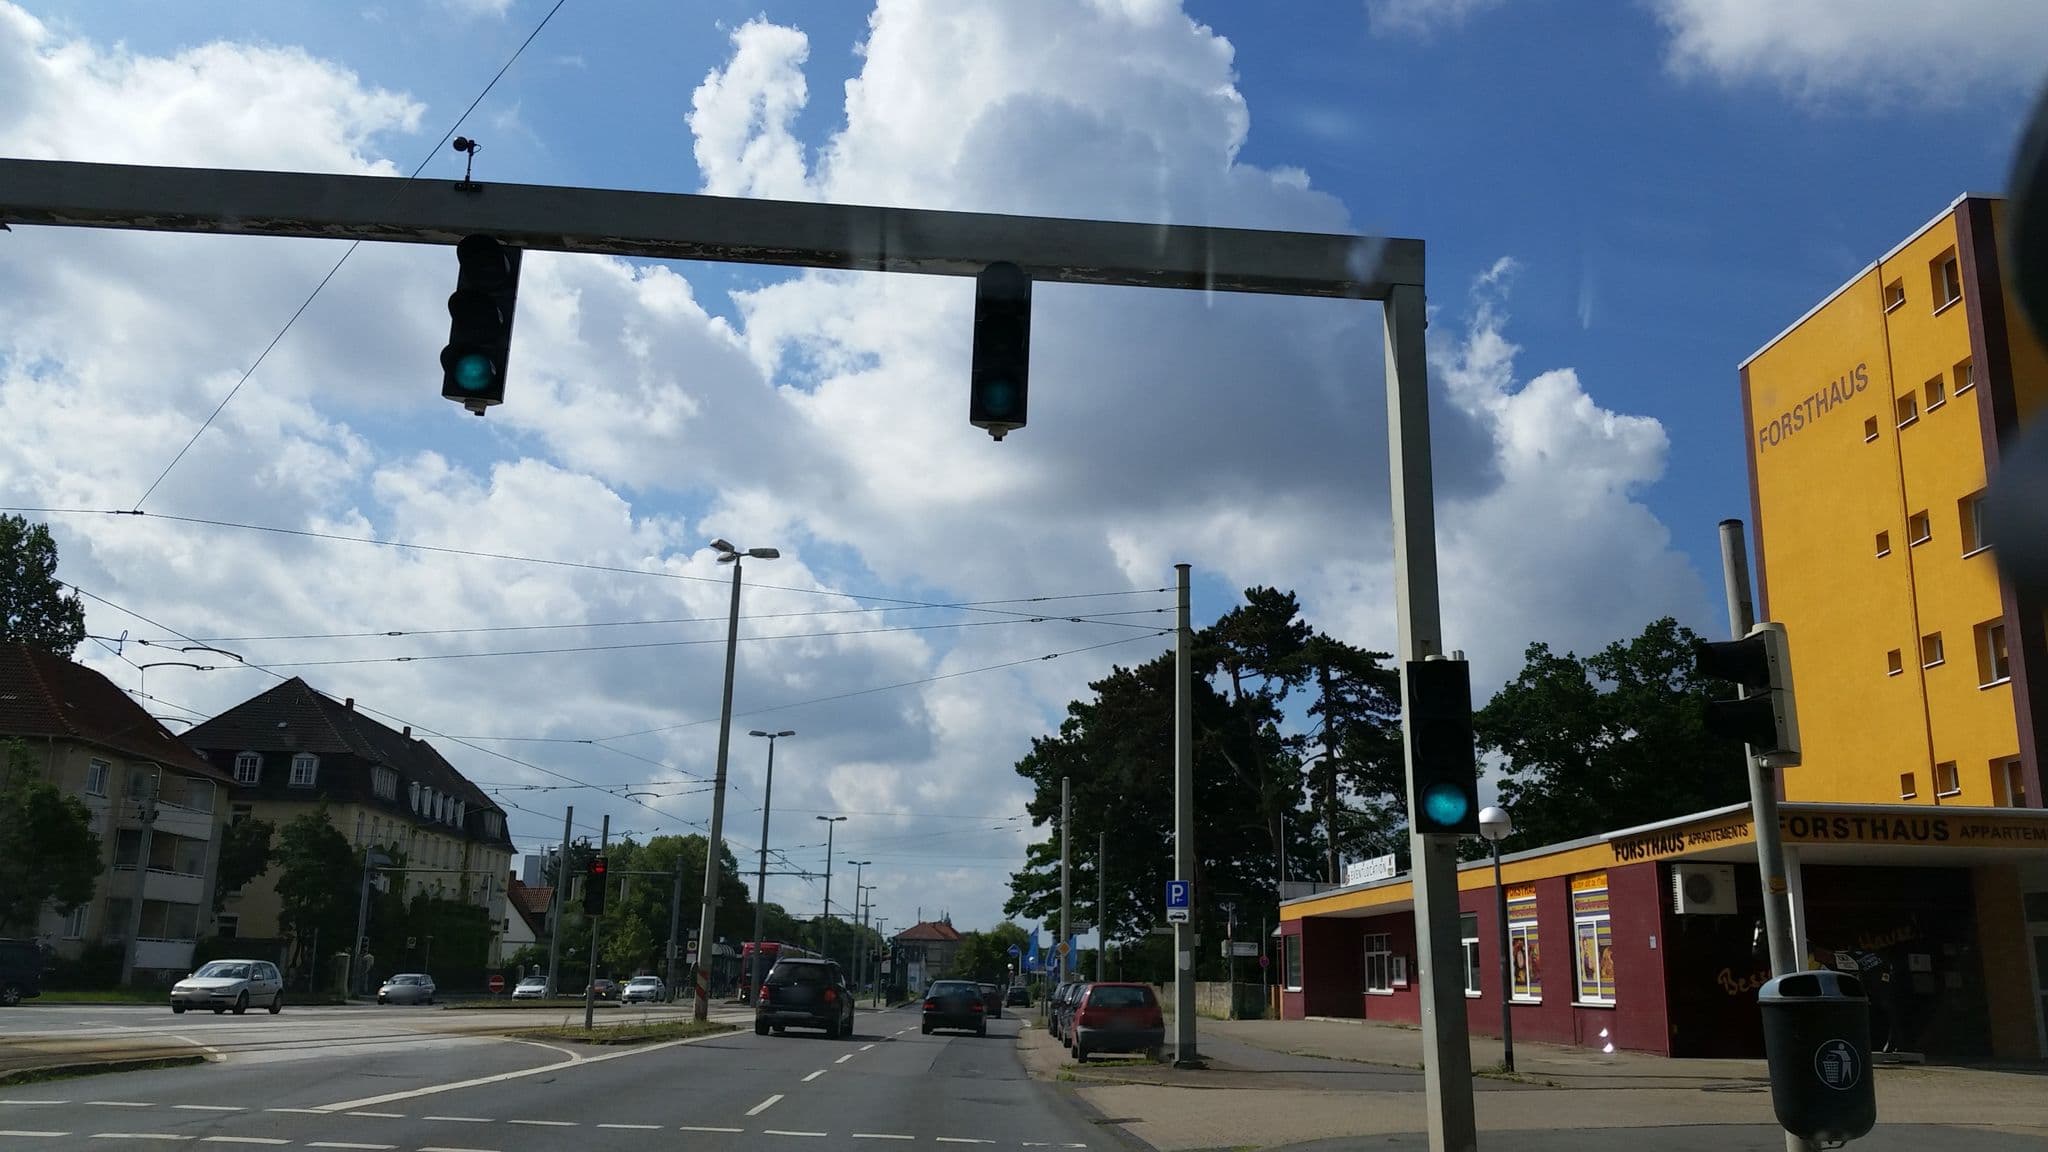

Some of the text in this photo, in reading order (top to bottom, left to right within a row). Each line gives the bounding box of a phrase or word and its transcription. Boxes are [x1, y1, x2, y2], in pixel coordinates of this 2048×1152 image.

[1759, 363, 1869, 453] FORSTHAUS
[1615, 824, 1748, 862] FORSTHAUS APPARTEMENTS
[1172, 884, 1183, 904] P
